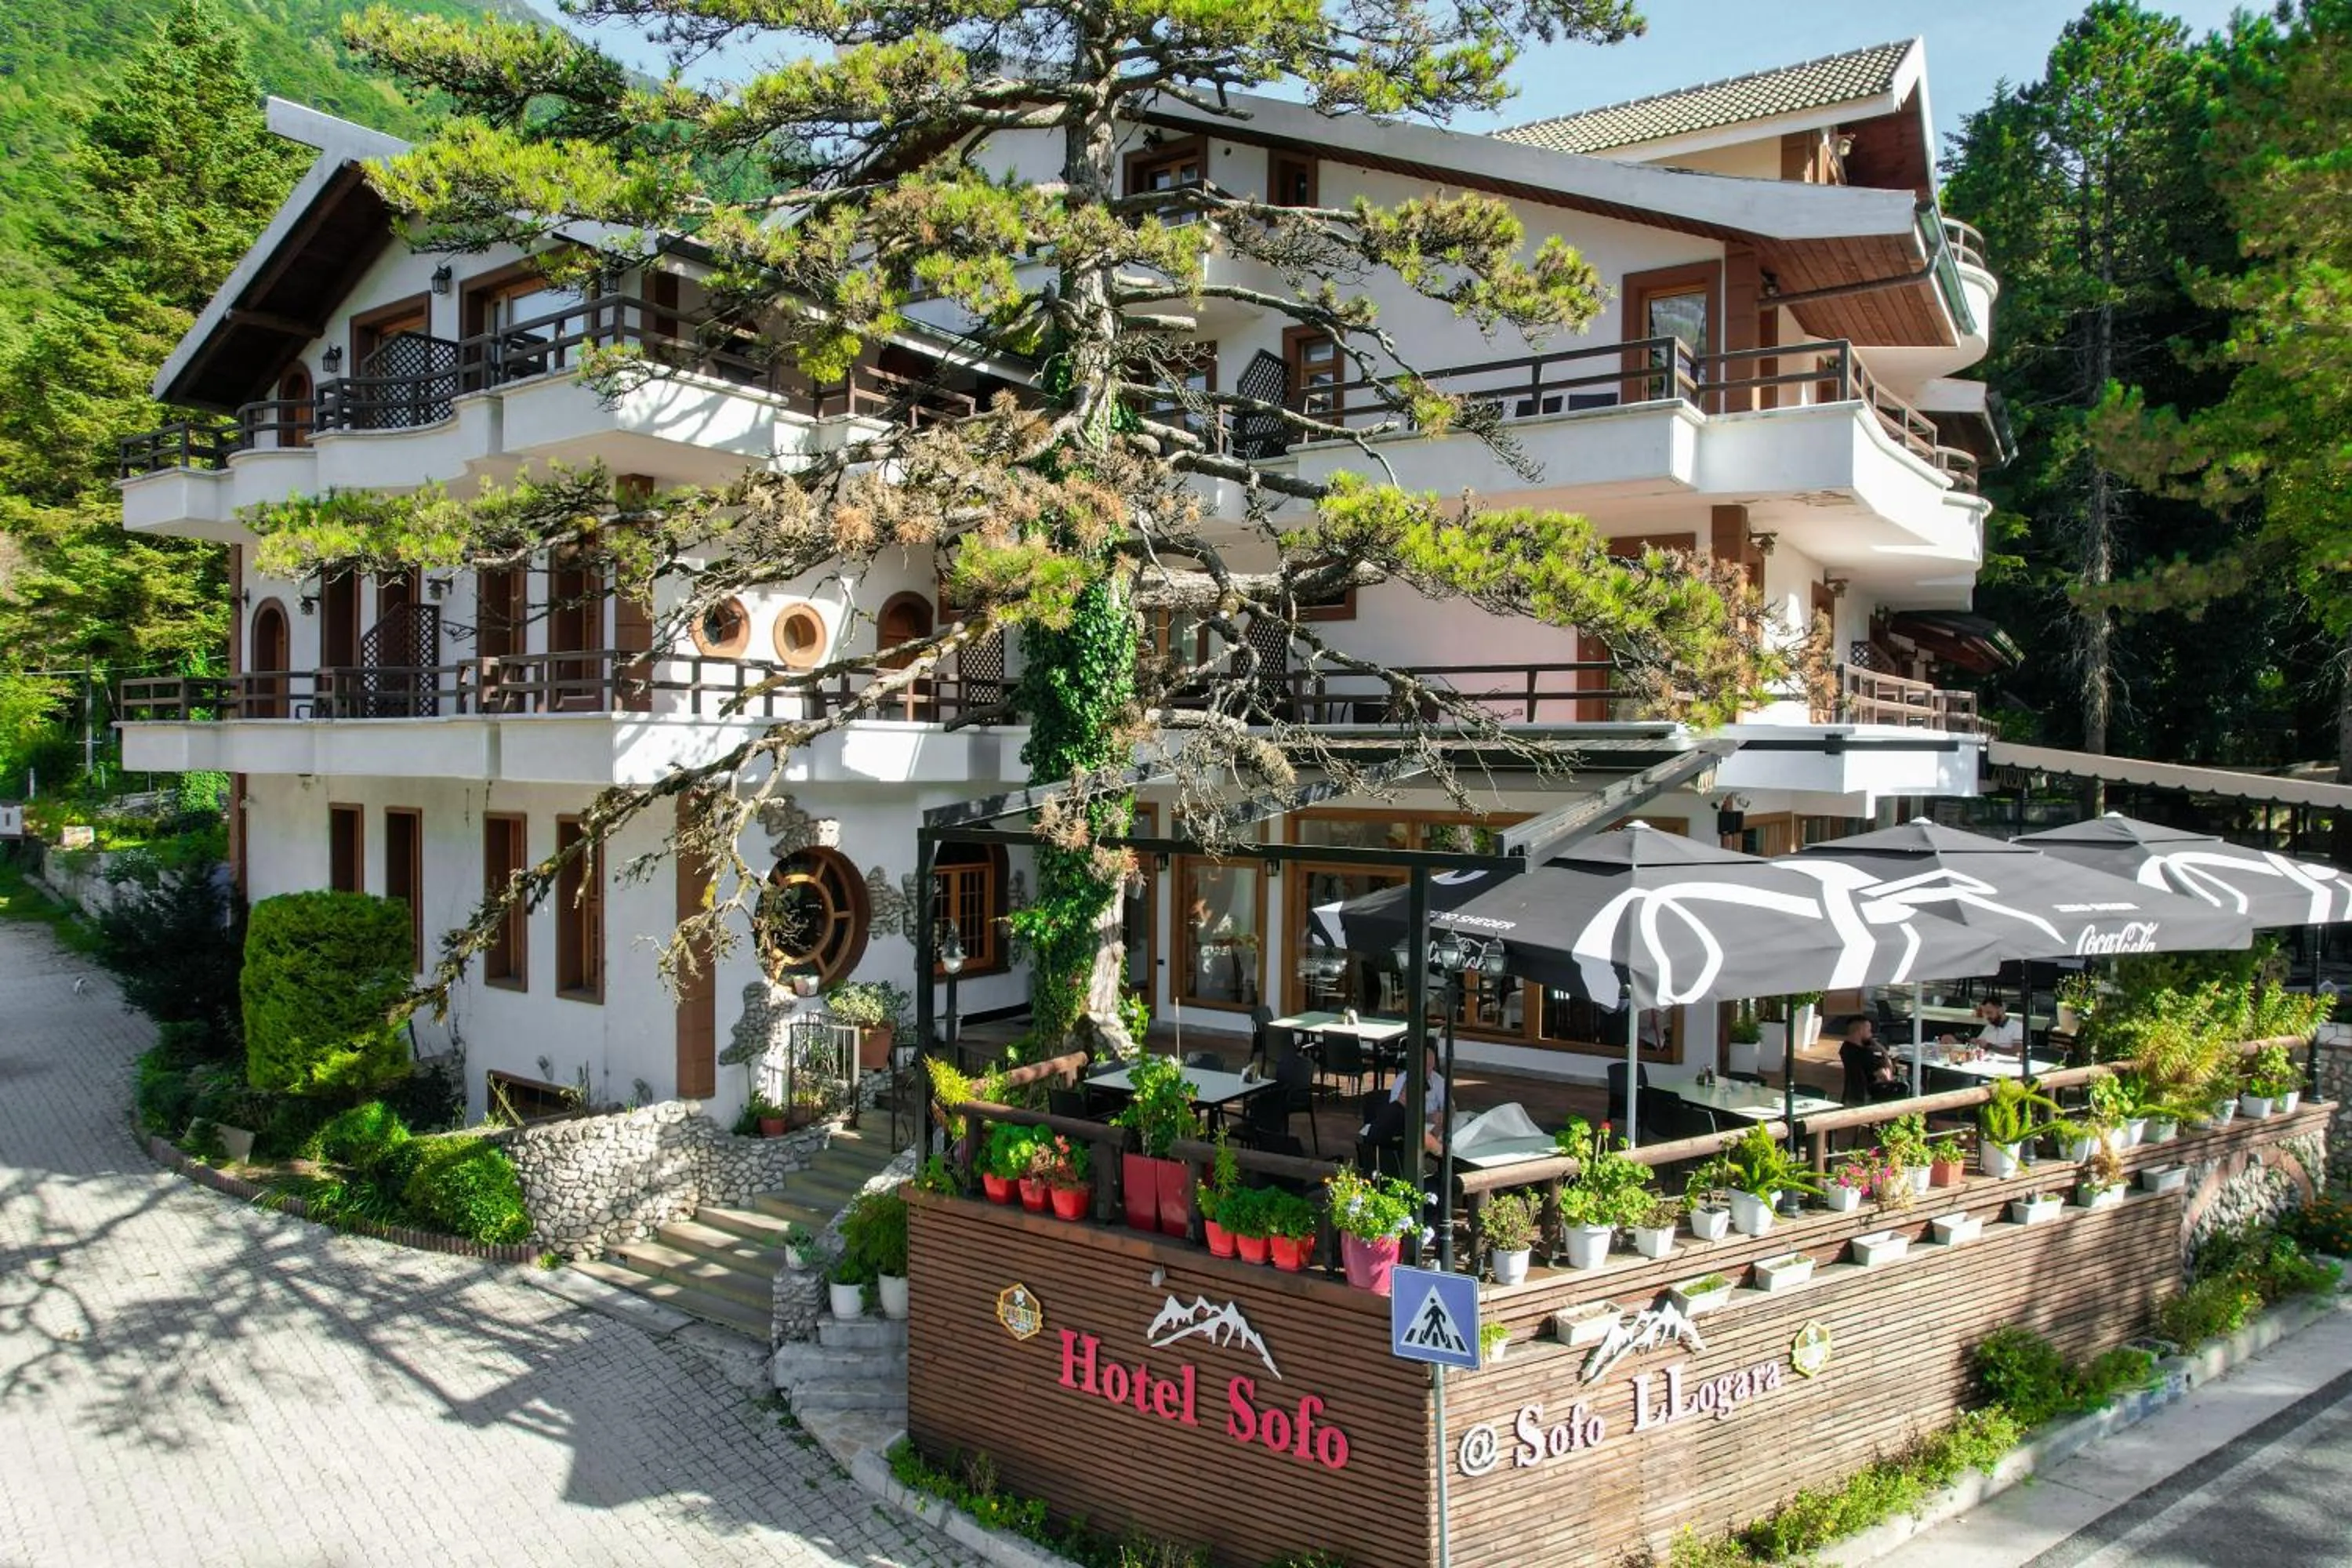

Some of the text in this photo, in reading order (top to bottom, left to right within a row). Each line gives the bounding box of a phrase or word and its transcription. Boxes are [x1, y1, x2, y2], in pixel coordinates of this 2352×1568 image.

[1057, 1328, 1350, 1470] Hotel Sofo
[1457, 1422, 1499, 1477] @
[1512, 1400, 1606, 1468] Sofo
